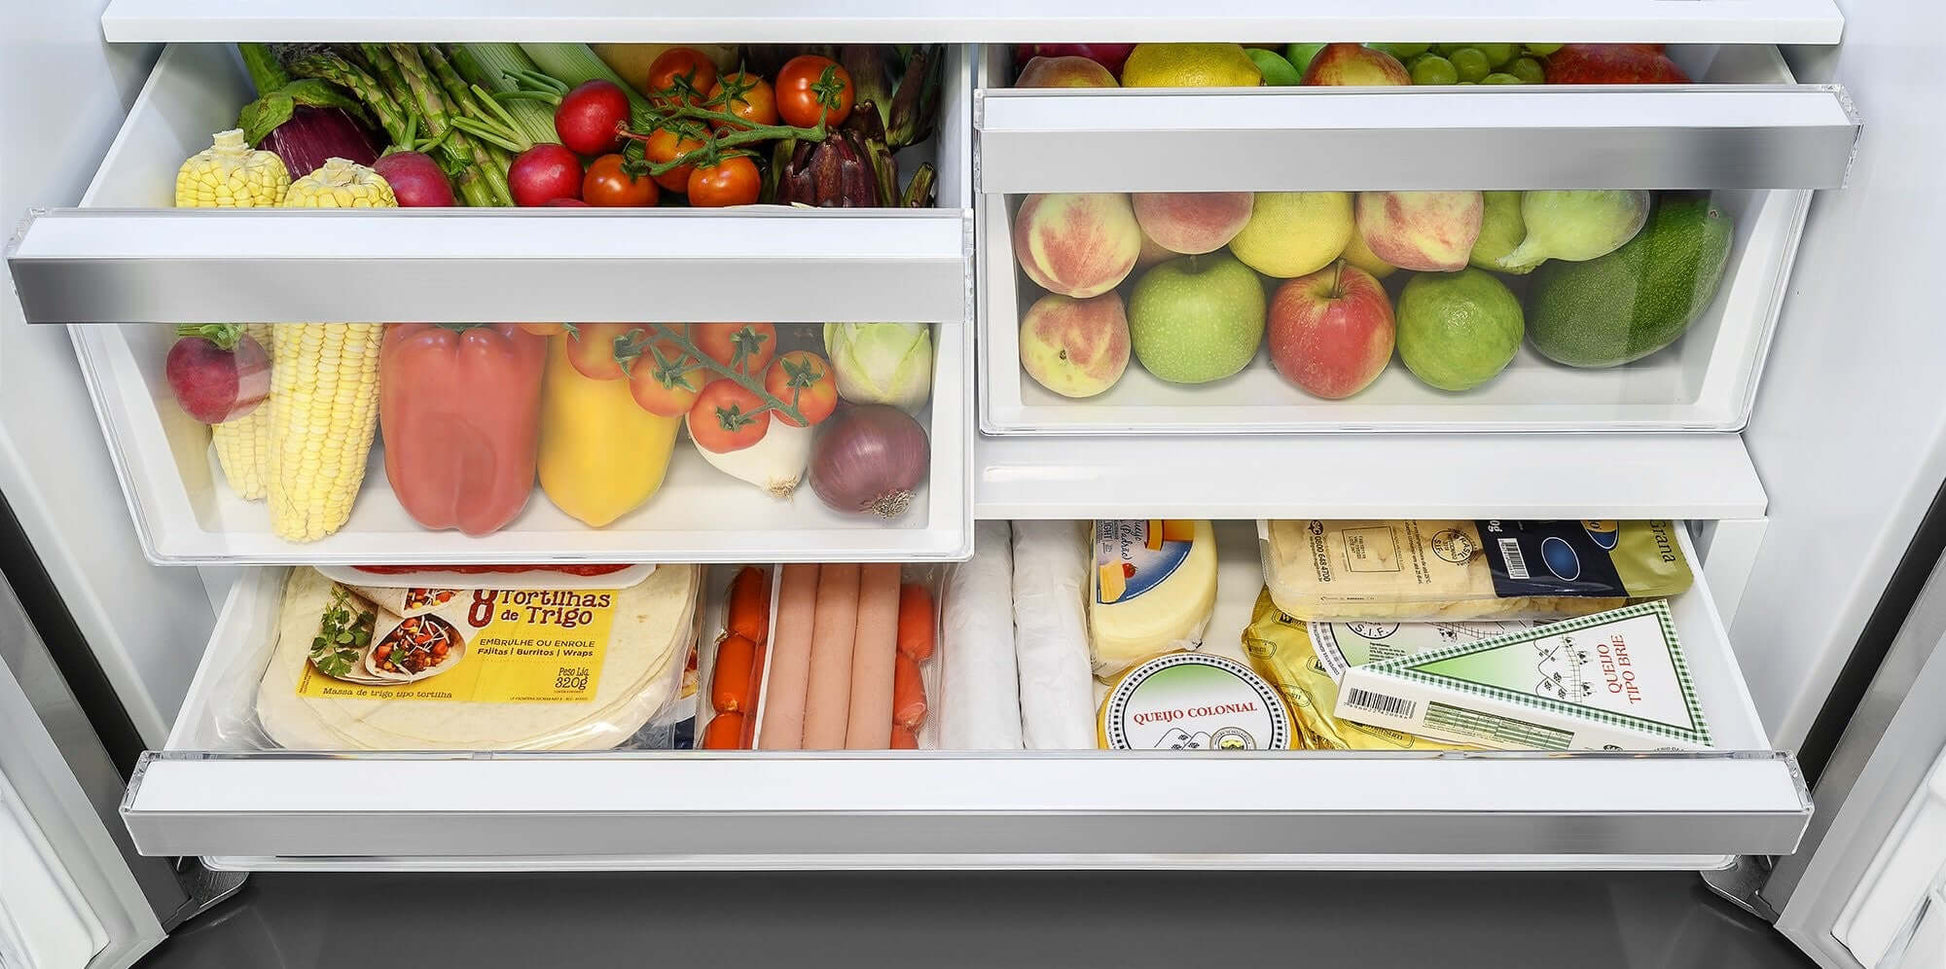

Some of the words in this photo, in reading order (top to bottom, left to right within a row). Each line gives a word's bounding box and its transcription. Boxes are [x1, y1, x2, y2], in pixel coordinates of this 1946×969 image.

[1314, 536, 1325, 553] 0800
[1650, 520, 1675, 563] Grana
[468, 589, 498, 628] 8
[500, 590, 610, 608] Tortilhas
[501, 609, 519, 621] de
[526, 606, 593, 628] Trigo
[477, 647, 508, 656] Fajitas
[516, 648, 554, 656] Burritos
[563, 649, 593, 657] Wraps
[480, 638, 533, 647] EMBRULHE
[536, 639, 552, 647] OU
[554, 640, 596, 648] ENROLE
[1611, 634, 1631, 666] BRIE
[558, 667, 575, 676] Peso
[1597, 644, 1622, 693] QUEIJO
[322, 687, 353, 696] Massa
[356, 688, 368, 696] de
[371, 689, 393, 699] trigo
[396, 690, 414, 699] tipo
[416, 690, 452, 698] tortilha
[555, 676, 589, 690] 320g
[1622, 670, 1641, 704] TIPO
[1133, 709, 1184, 725] QUEIJO
[1188, 702, 1257, 718] COLONIAL
